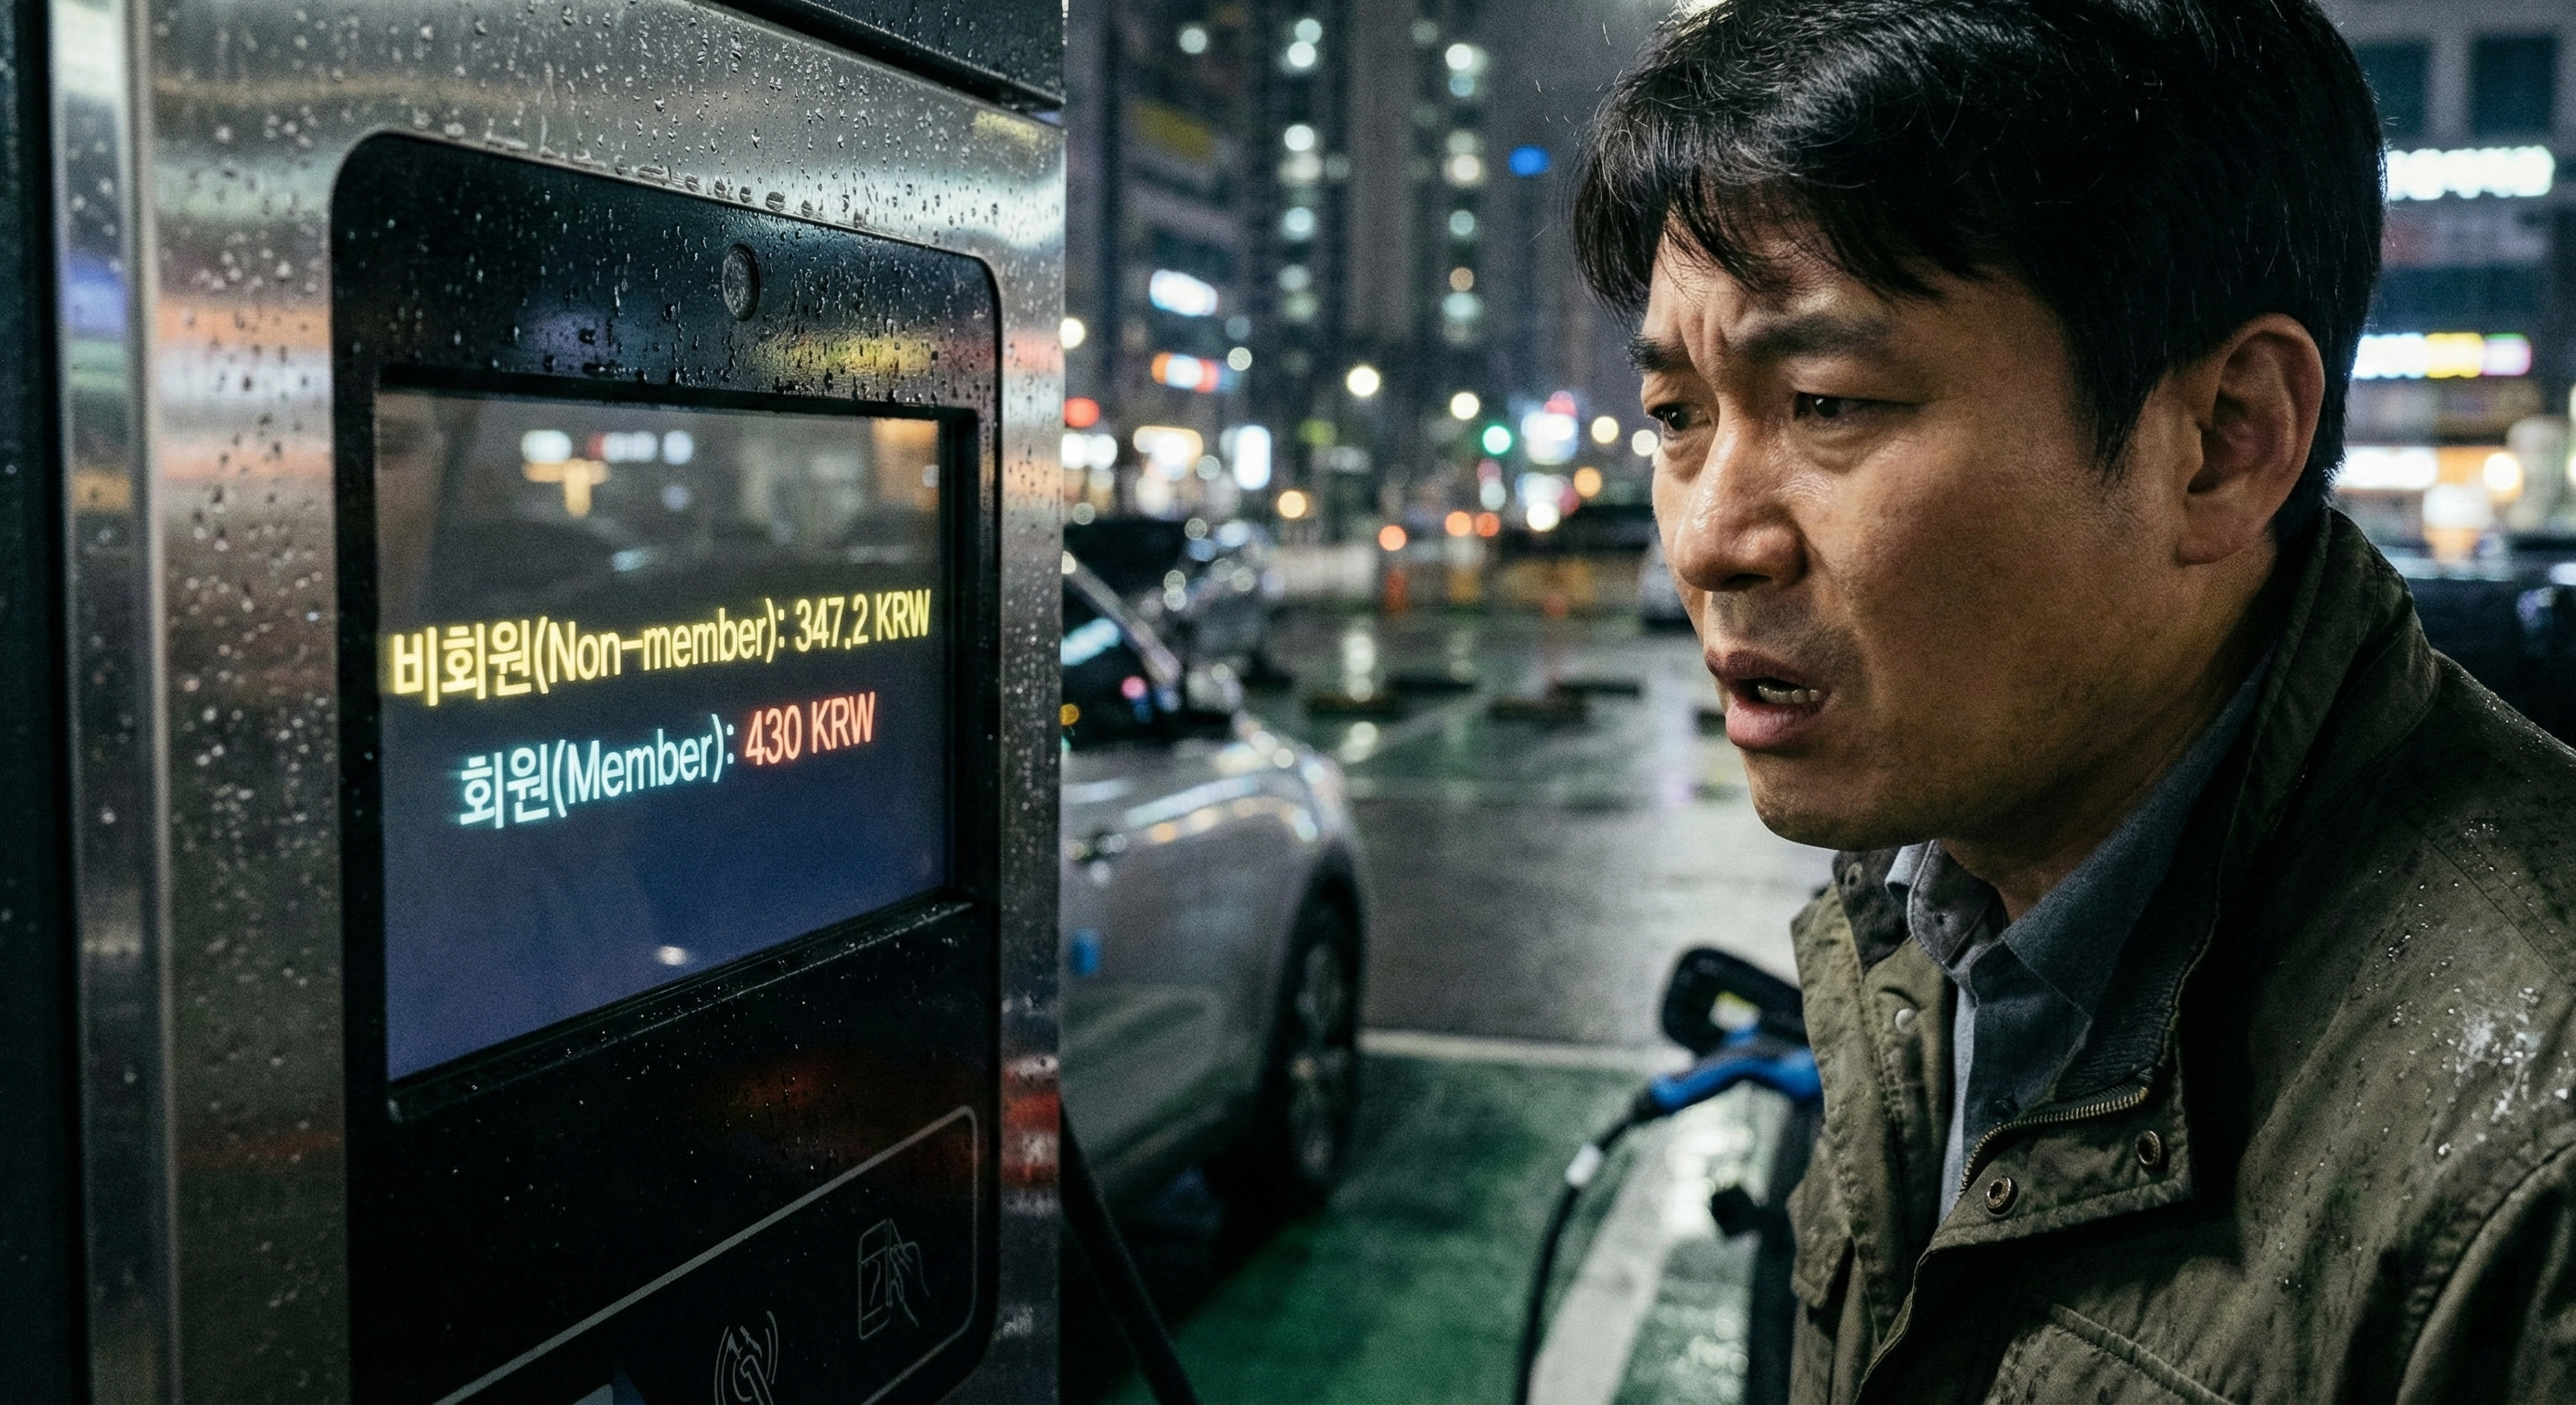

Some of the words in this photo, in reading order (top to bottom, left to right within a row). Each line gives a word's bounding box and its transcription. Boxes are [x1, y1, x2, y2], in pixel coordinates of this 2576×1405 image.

[392, 597, 786, 707] 비회원(Non-member):
[875, 588, 931, 642] KRW
[458, 713, 735, 830] 회원(Member):
[744, 704, 802, 767] 430
[810, 691, 875, 755] KRW
